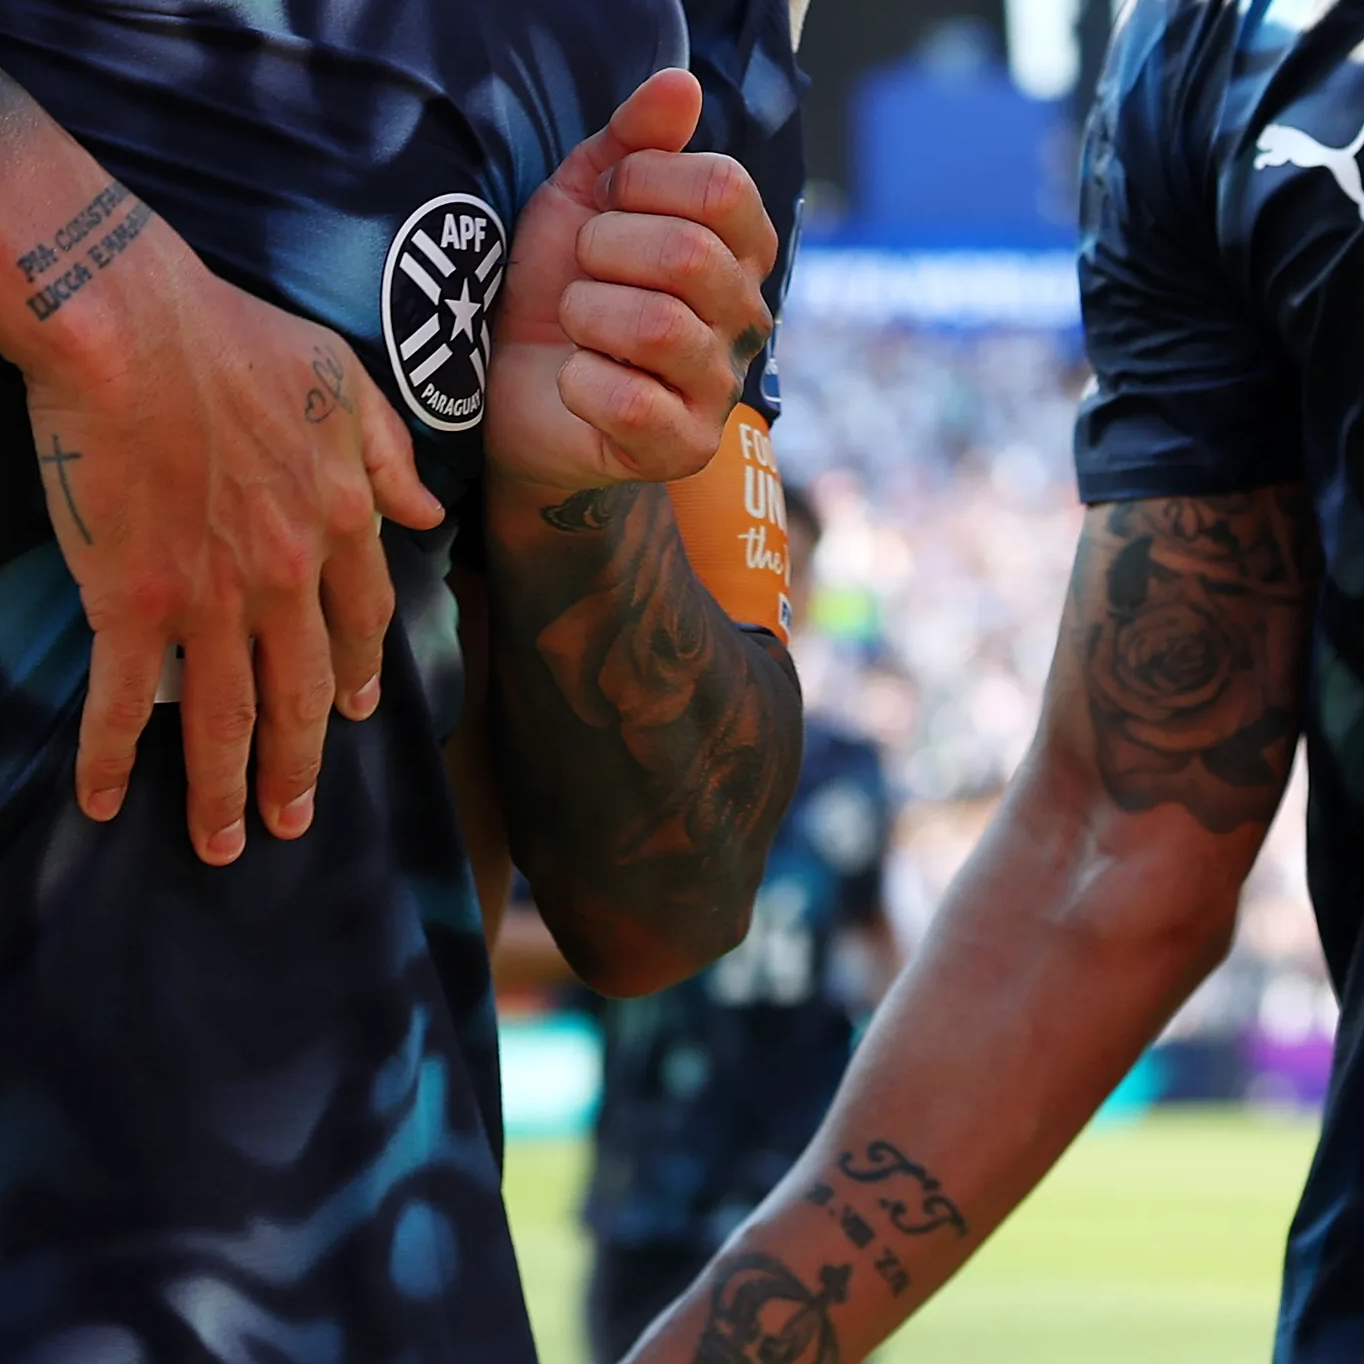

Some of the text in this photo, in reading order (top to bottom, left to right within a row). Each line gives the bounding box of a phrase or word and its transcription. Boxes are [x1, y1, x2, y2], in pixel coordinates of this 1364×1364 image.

[440, 213, 487, 253] APF
[25, 262, 93, 322] LUCCA
[738, 525, 783, 574] the
